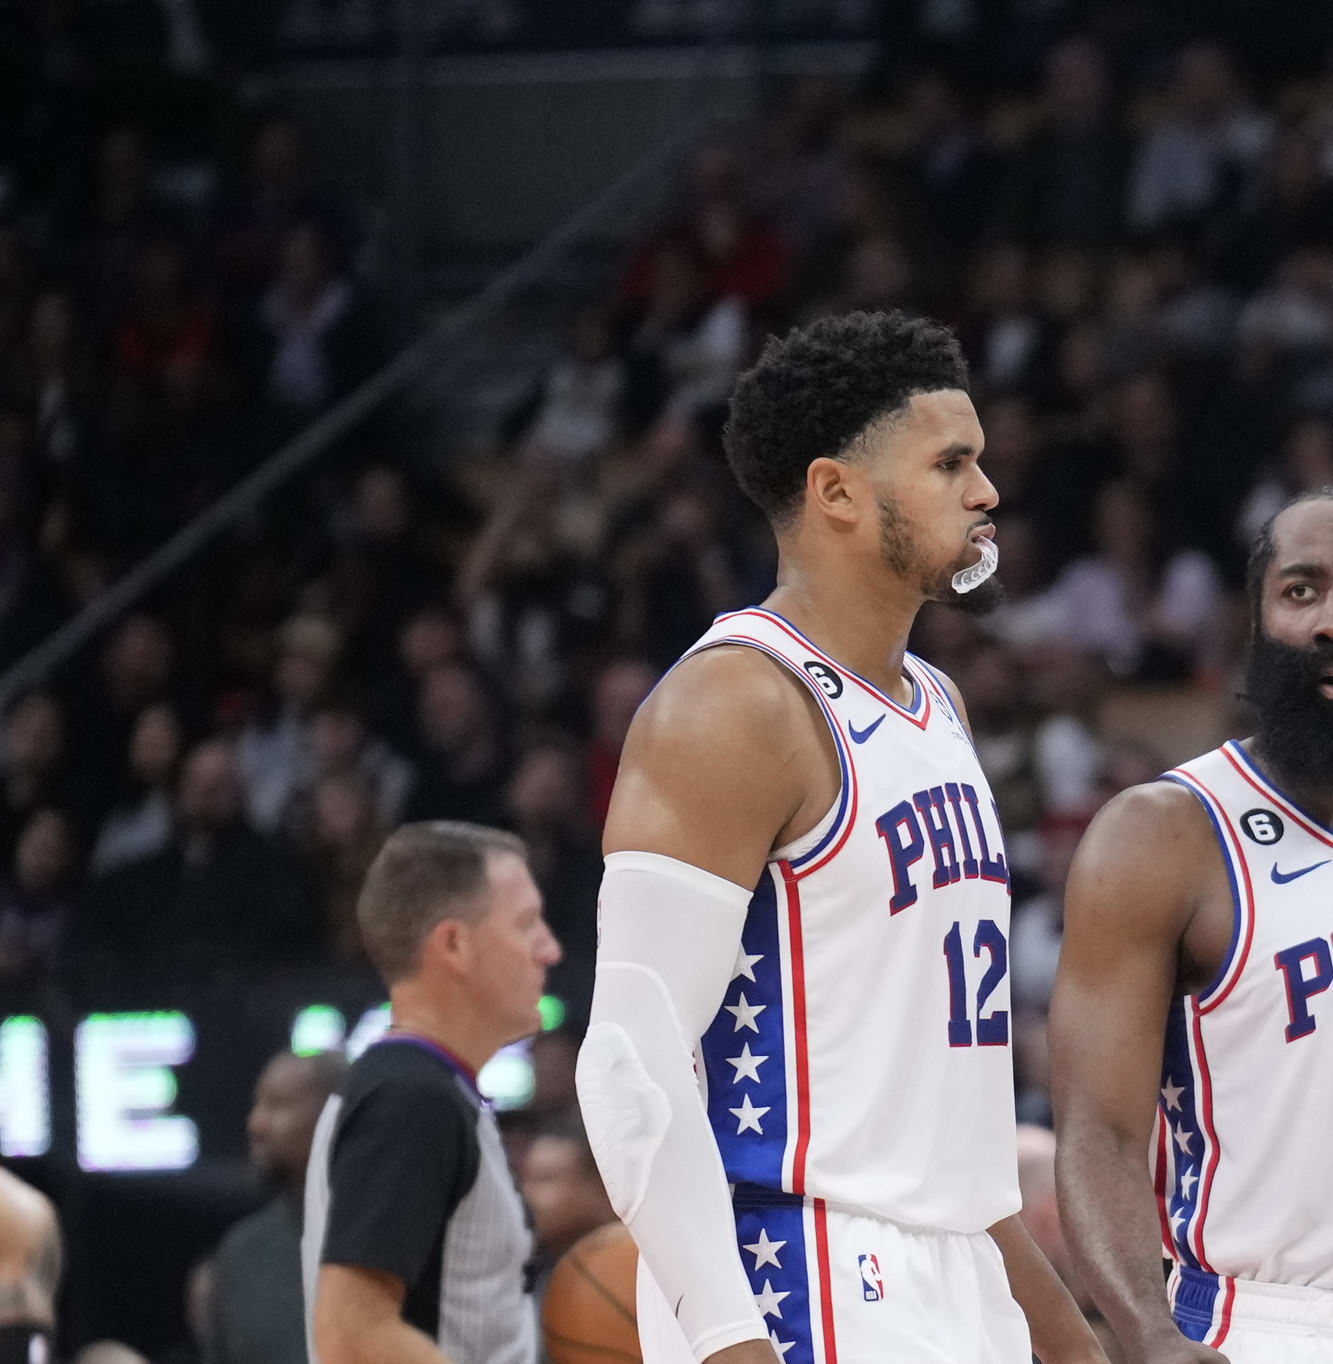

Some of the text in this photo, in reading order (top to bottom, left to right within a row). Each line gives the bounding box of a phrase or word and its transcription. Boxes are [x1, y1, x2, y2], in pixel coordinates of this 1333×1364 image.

[807, 664, 838, 696] 6
[1246, 815, 1277, 844] 6
[943, 919, 1009, 1048] 12
